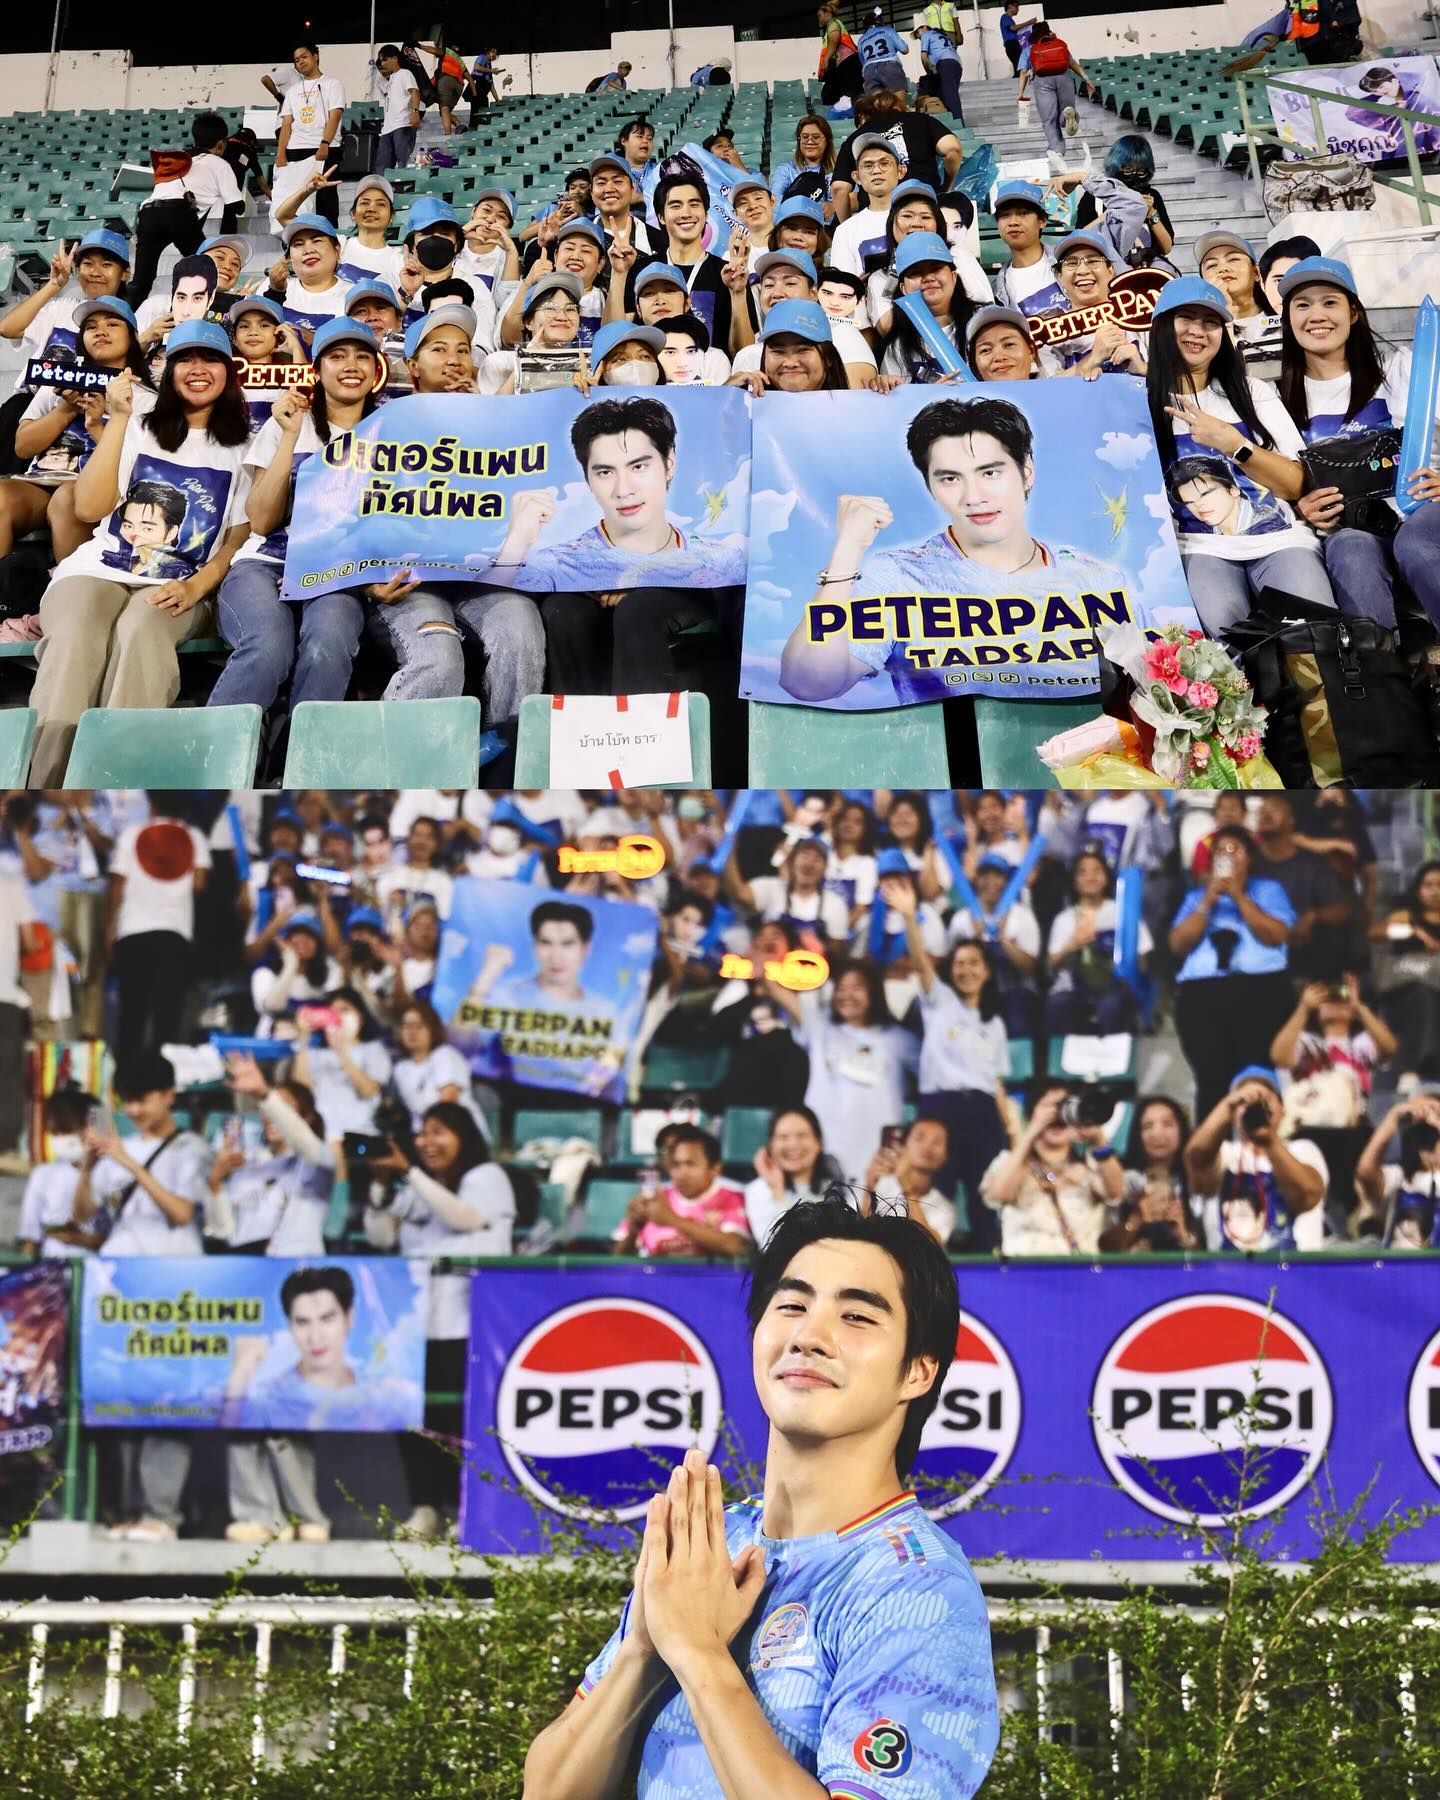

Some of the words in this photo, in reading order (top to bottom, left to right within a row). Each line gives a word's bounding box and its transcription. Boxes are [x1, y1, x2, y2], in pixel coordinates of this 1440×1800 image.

[863, 38, 890, 59] 23
[31, 363, 114, 387] peterpa
[361, 480, 502, 517] ทัศน์พล
[810, 591, 1132, 642] PETERPAN
[1027, 674, 1100, 687] peterp
[634, 734, 662, 745] ธาร
[460, 1004, 613, 1038] PETERPAN
[515, 1388, 703, 1430] PEPSI
[1111, 1387, 1314, 1431] PEPSI
[865, 1727, 906, 1770] 3
